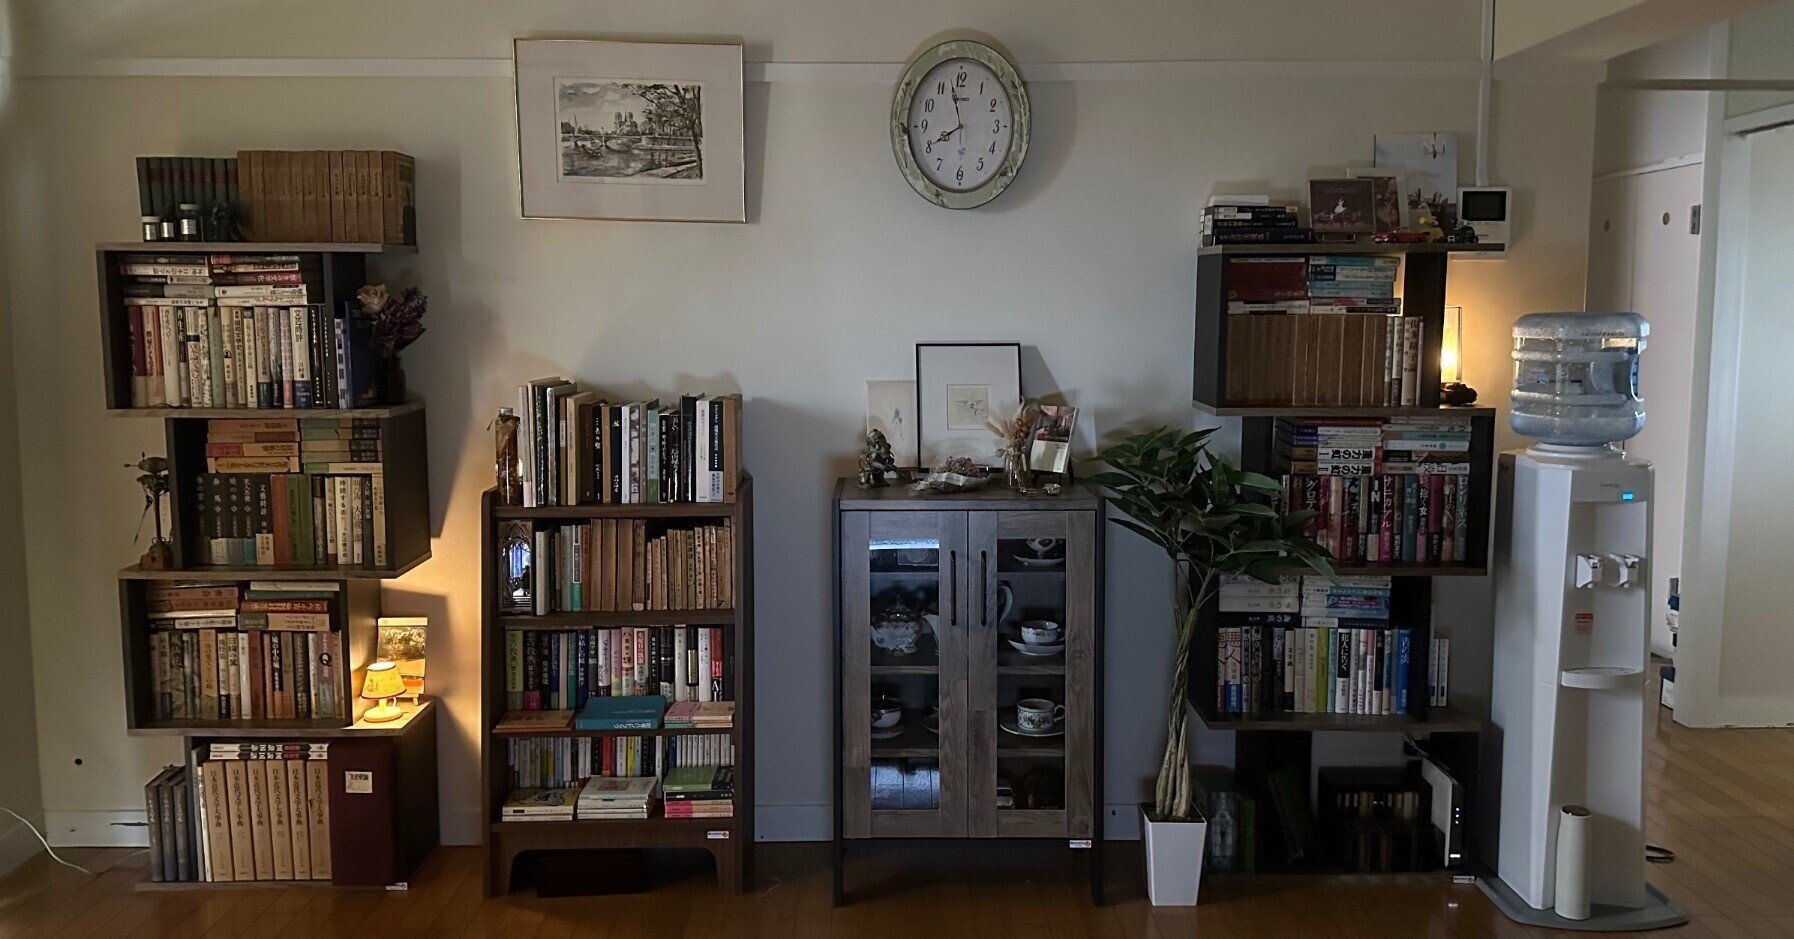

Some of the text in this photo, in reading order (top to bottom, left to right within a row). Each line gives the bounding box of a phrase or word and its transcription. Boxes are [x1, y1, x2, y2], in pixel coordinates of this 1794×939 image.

[956, 71, 967, 88] 12
[937, 82, 945, 95] 11
[979, 82, 984, 95] 1
[924, 98, 935, 112] 10
[989, 98, 997, 112] 2
[921, 119, 928, 134] 9
[992, 119, 1000, 133] 3
[925, 140, 933, 154] 8
[989, 140, 996, 155] 4
[936, 158, 944, 171] 7
[976, 158, 984, 171] 5
[956, 165, 964, 181] 6
[1331, 449, 1373, 460] 重力の虹
[1330, 465, 1372, 475] 重力の虹
[1371, 480, 1380, 503] IN
[1305, 479, 1318, 528] グロテク
[1267, 614, 1290, 624] 海の底
[271, 636, 281, 669] 城の中の城
[1341, 633, 1349, 672] 犯人に告ぐ
[1400, 636, 1411, 664] 青の炎
[210, 768, 223, 829] 日本近代文学大事典
[232, 768, 245, 828] 日本近代文学大事典
[252, 767, 265, 827] 日本近代文学大事典
[272, 767, 285, 827] 日本近代文学大事典
[292, 767, 304, 827] 日本近代文学大事典
